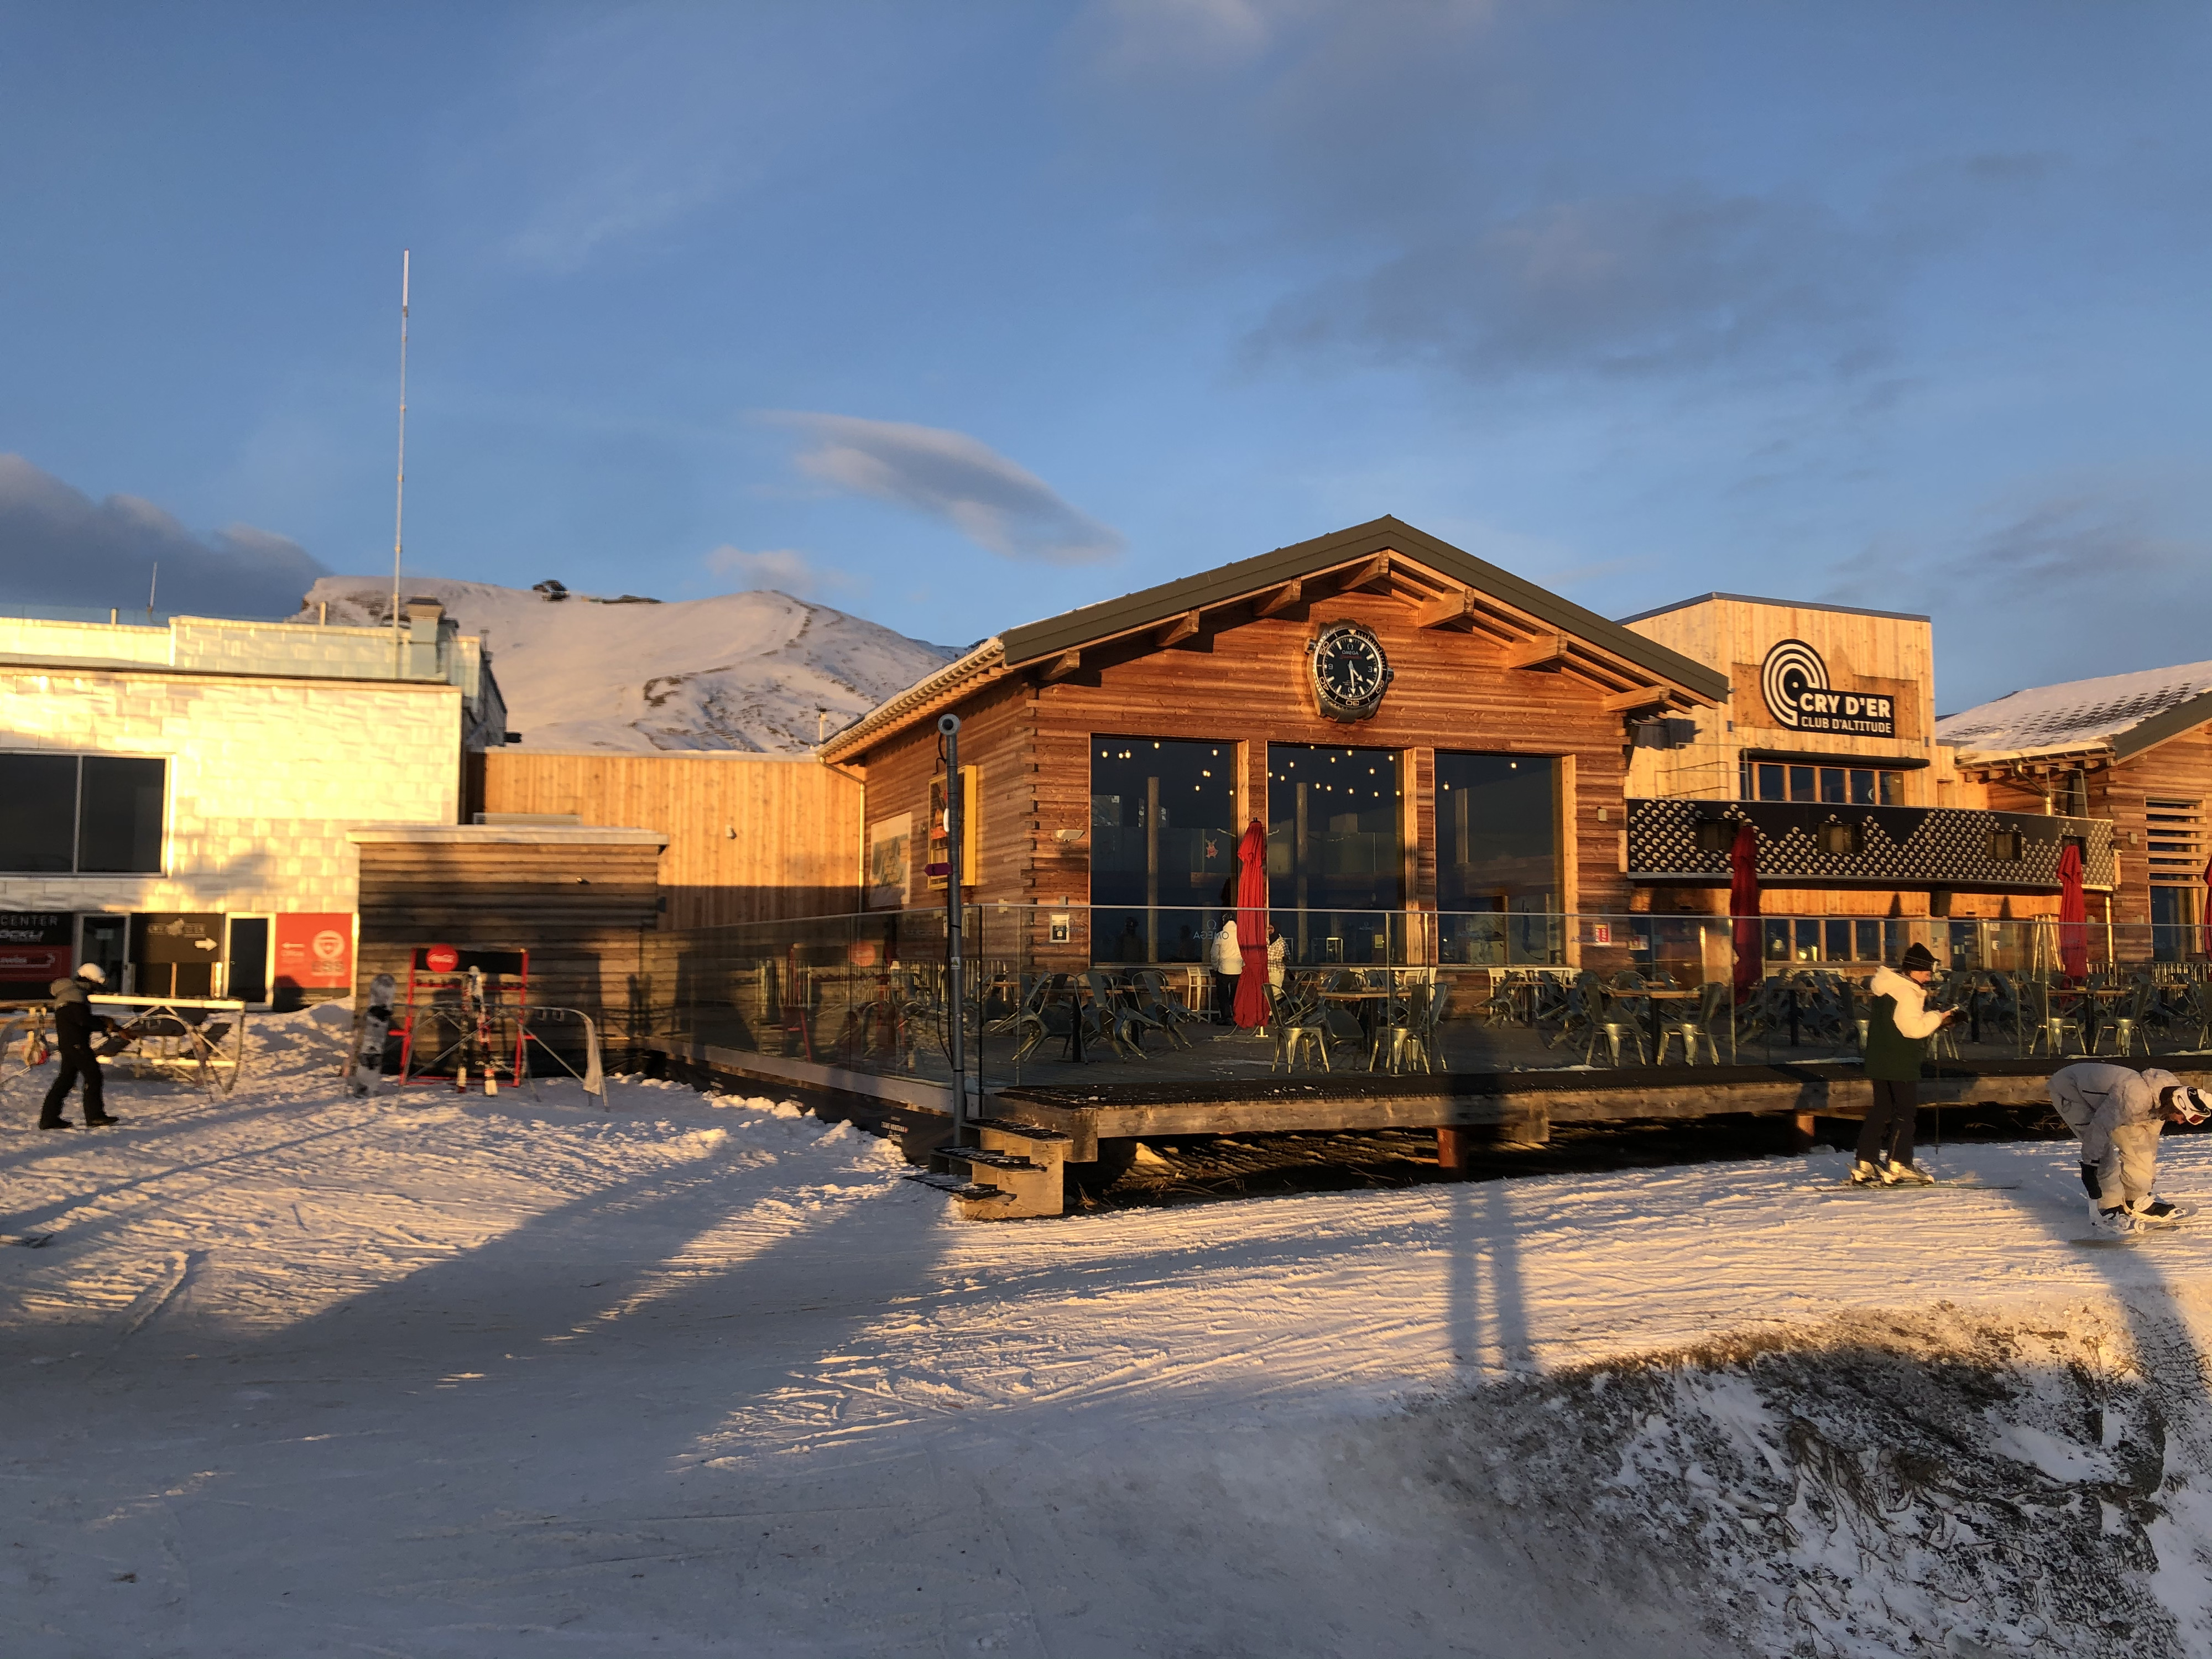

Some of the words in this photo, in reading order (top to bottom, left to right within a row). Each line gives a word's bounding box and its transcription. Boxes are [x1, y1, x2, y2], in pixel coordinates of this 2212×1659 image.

[1799, 692, 1840, 713] CRY
[1845, 696, 1891, 718] D'ER
[1801, 716, 1829, 728] CLUB
[1832, 719, 1891, 733] D'ALTITUDE
[1, 915, 58, 926] CENTER
